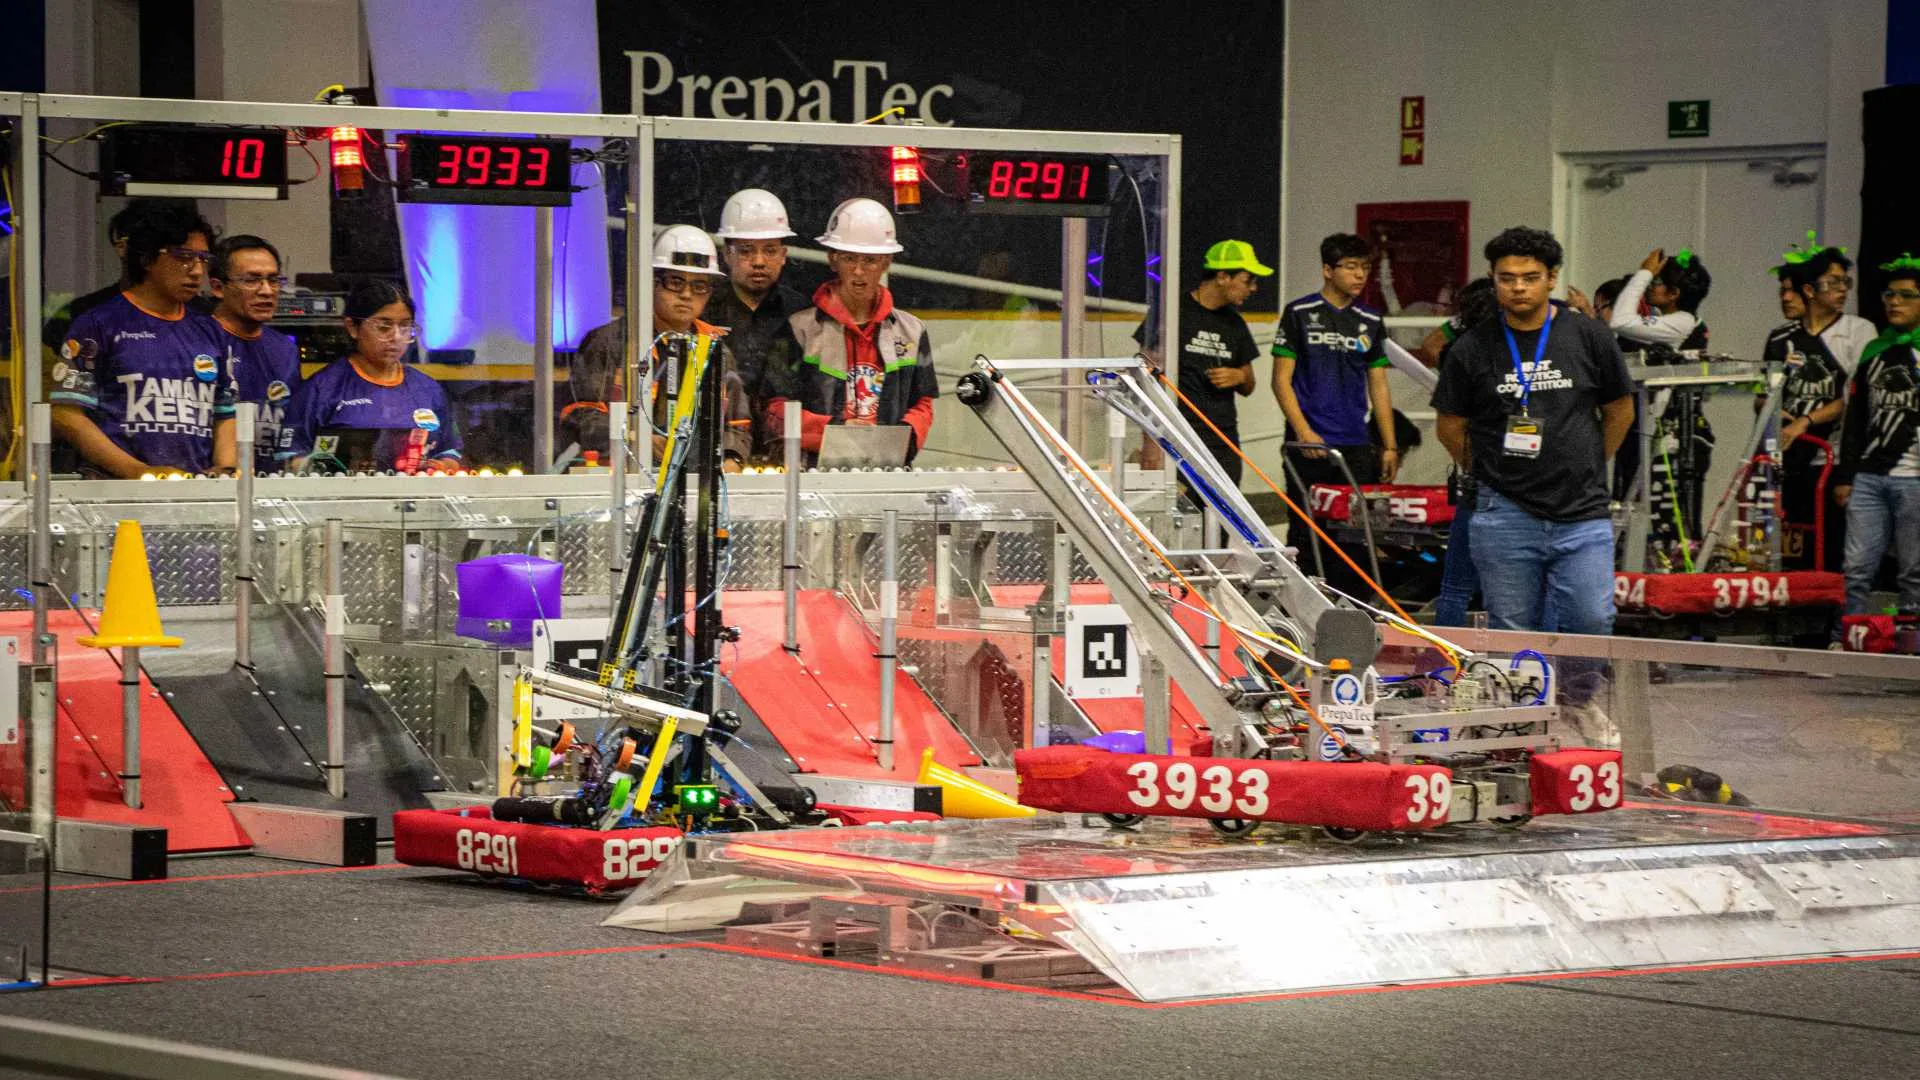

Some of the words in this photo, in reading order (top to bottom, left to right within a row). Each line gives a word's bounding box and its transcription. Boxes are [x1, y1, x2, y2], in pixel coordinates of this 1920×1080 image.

[623, 50, 955, 128] PrepaTec
[221, 139, 265, 180] 10
[436, 144, 550, 187] 3933
[988, 161, 1090, 199] 8291
[1712, 576, 1789, 608] 3794
[1322, 706, 1371, 722] PrepaTec
[1126, 761, 1270, 816] 3933
[1404, 772, 1451, 823] 39
[1569, 761, 1620, 811] 33
[456, 828, 518, 876] 8291
[603, 836, 684, 881] 829
